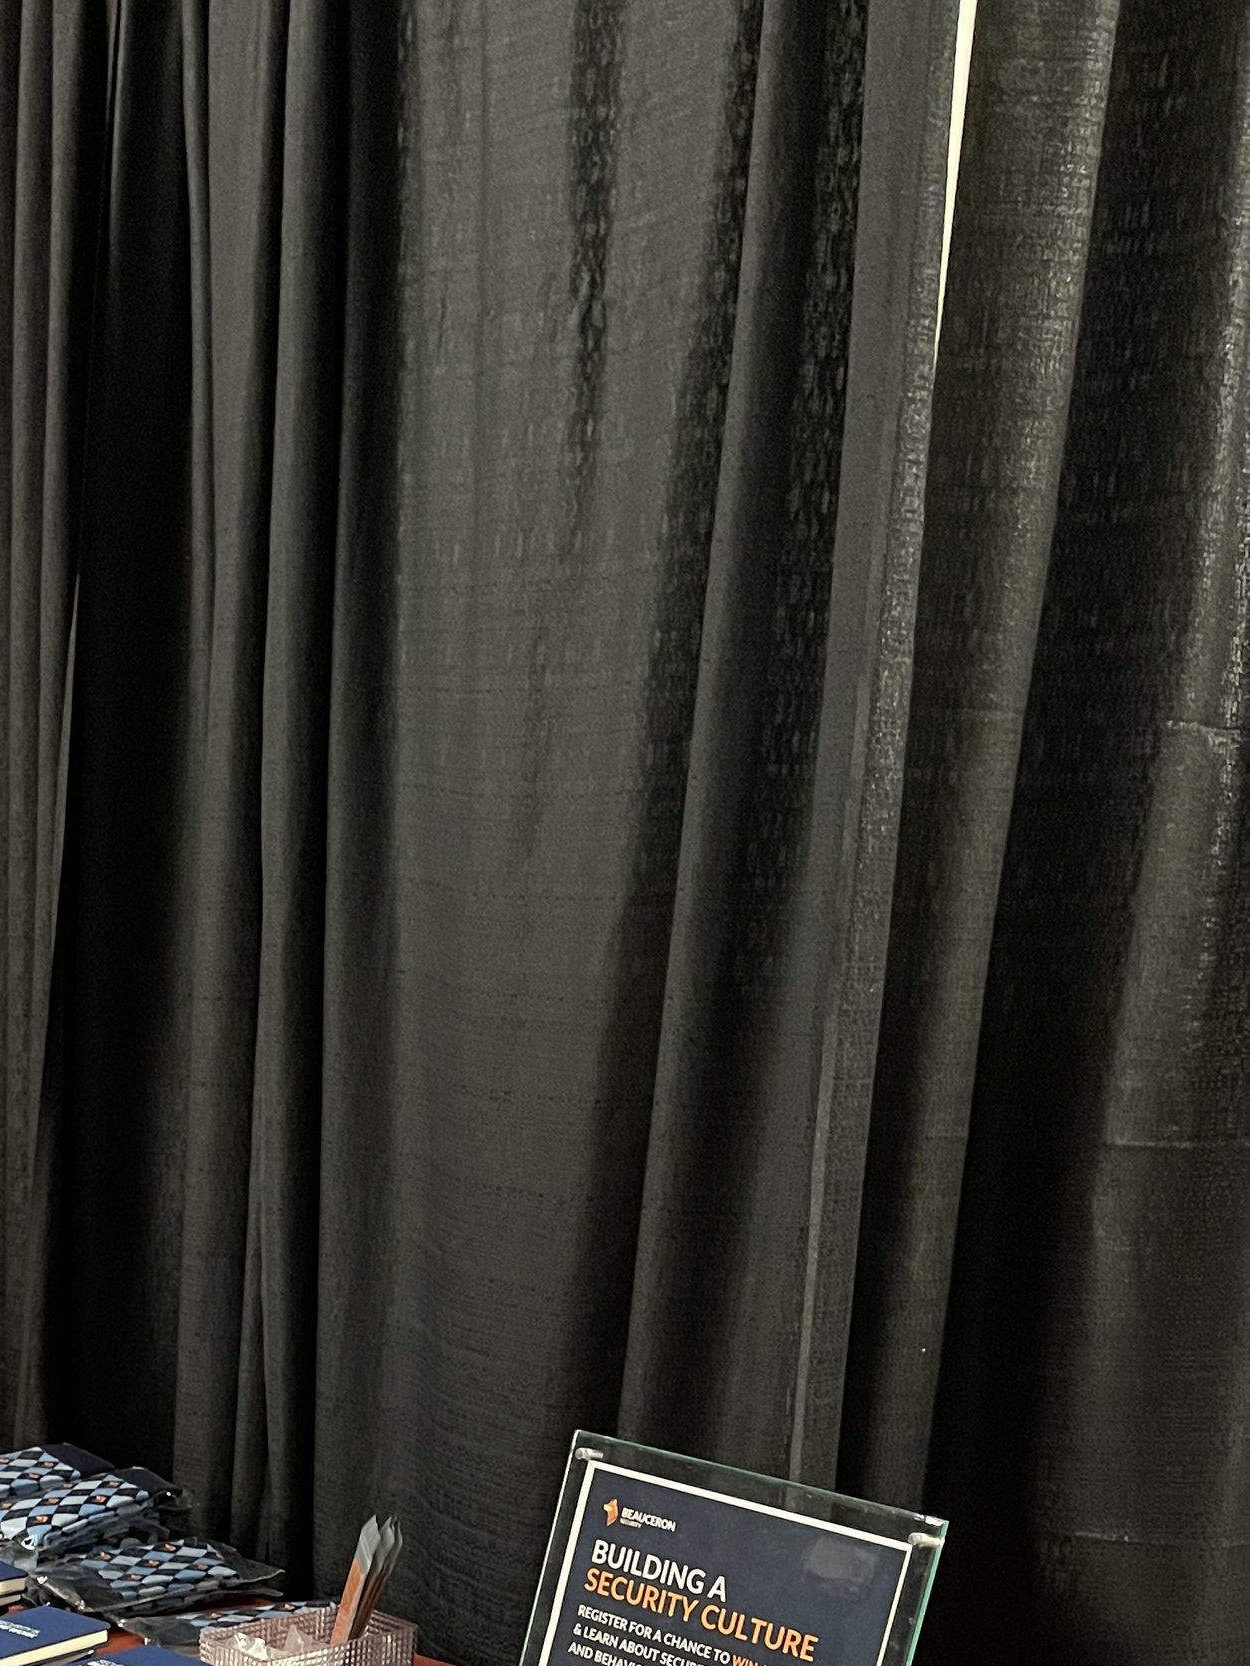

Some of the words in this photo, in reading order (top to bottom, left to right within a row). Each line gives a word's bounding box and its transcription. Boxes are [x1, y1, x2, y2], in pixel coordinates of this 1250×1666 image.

[621, 1507, 676, 1532] BEAUCERON
[591, 1539, 706, 1595] BUILDING
[707, 1575, 727, 1603] A
[578, 1604, 628, 1632] REGISTER
[628, 1621, 653, 1639] FOR
[652, 1629, 662, 1643] A
[664, 1633, 713, 1659] CHANCE
[713, 1649, 731, 1665] TO
[583, 1567, 700, 1623] SECURITY
[701, 1604, 819, 1662] CULTURE
[568, 1642, 594, 1659] AND
[573, 1623, 582, 1636] &
[583, 1626, 619, 1649] LEARN
[618, 1639, 661, 1662] ABOUT
